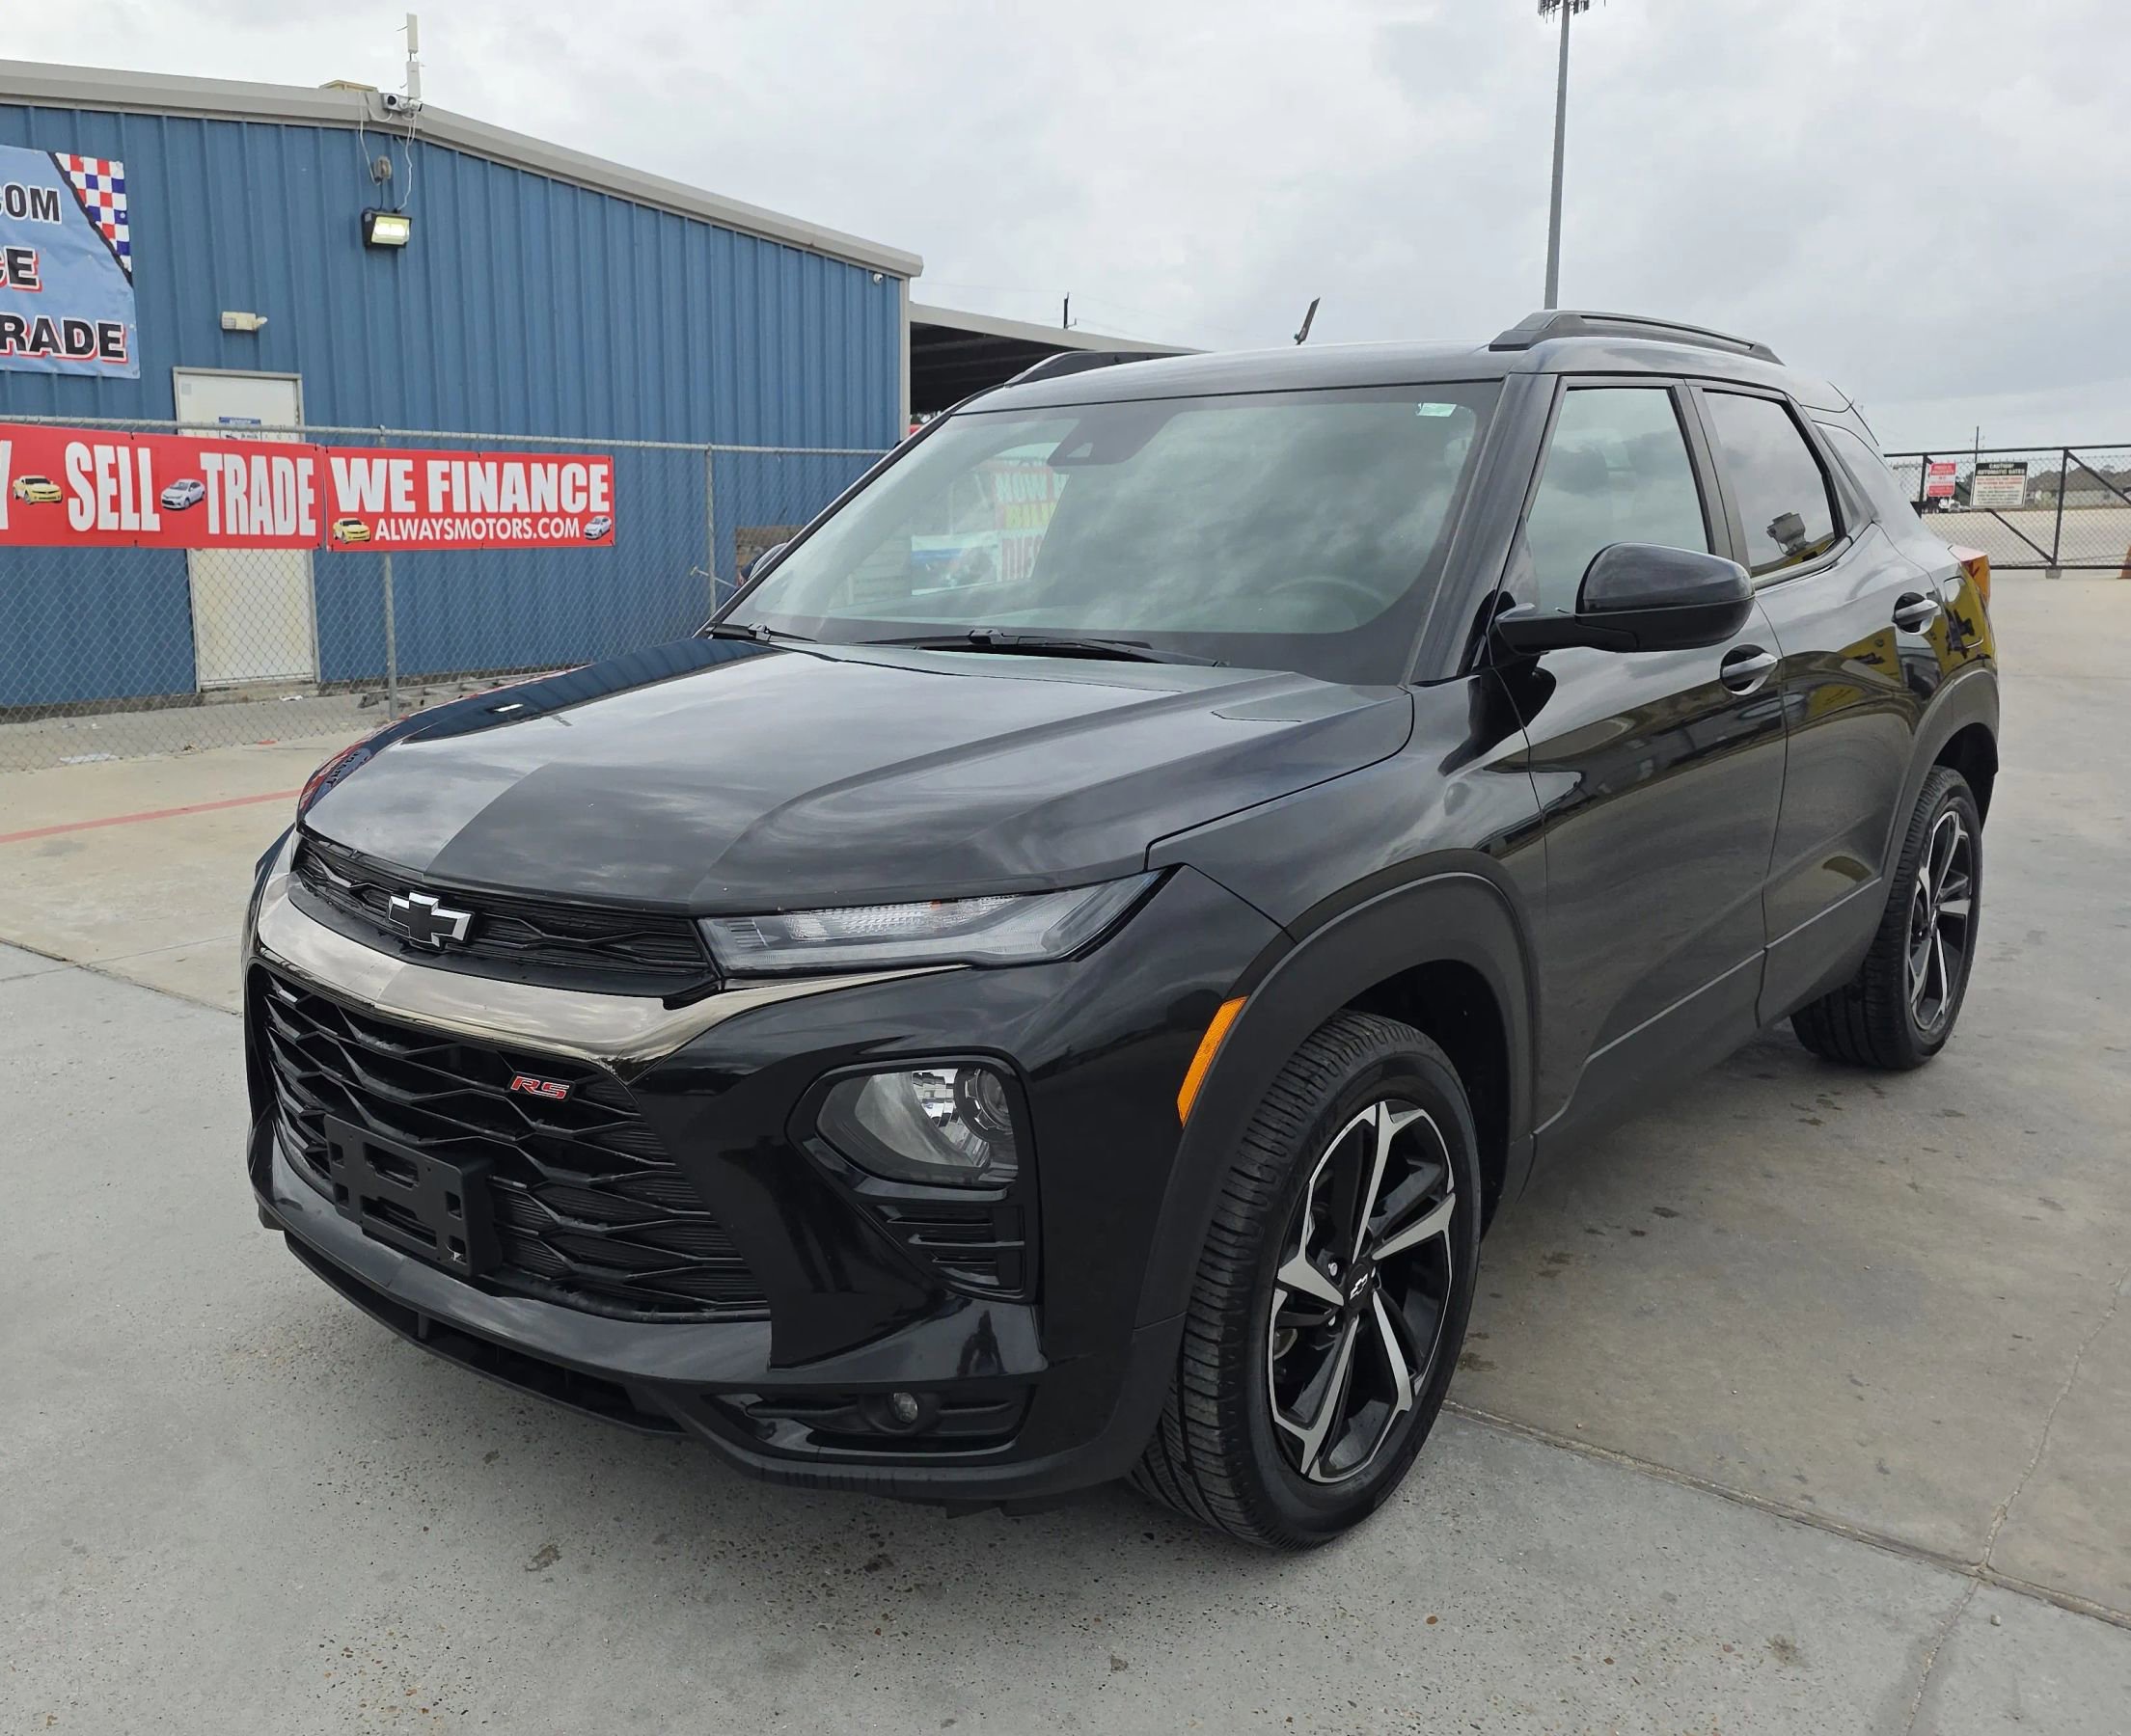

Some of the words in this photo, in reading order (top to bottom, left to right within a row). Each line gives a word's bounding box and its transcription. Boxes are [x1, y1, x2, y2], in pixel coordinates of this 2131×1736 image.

[0, 182, 61, 224] OM
[65, 441, 160, 532] SELL
[200, 452, 316, 536] TRADE
[330, 457, 416, 512] WE
[426, 459, 610, 513] FINANCE
[374, 517, 580, 541] ALWAYSMOTORS.COM
[510, 1075, 570, 1099] RS
